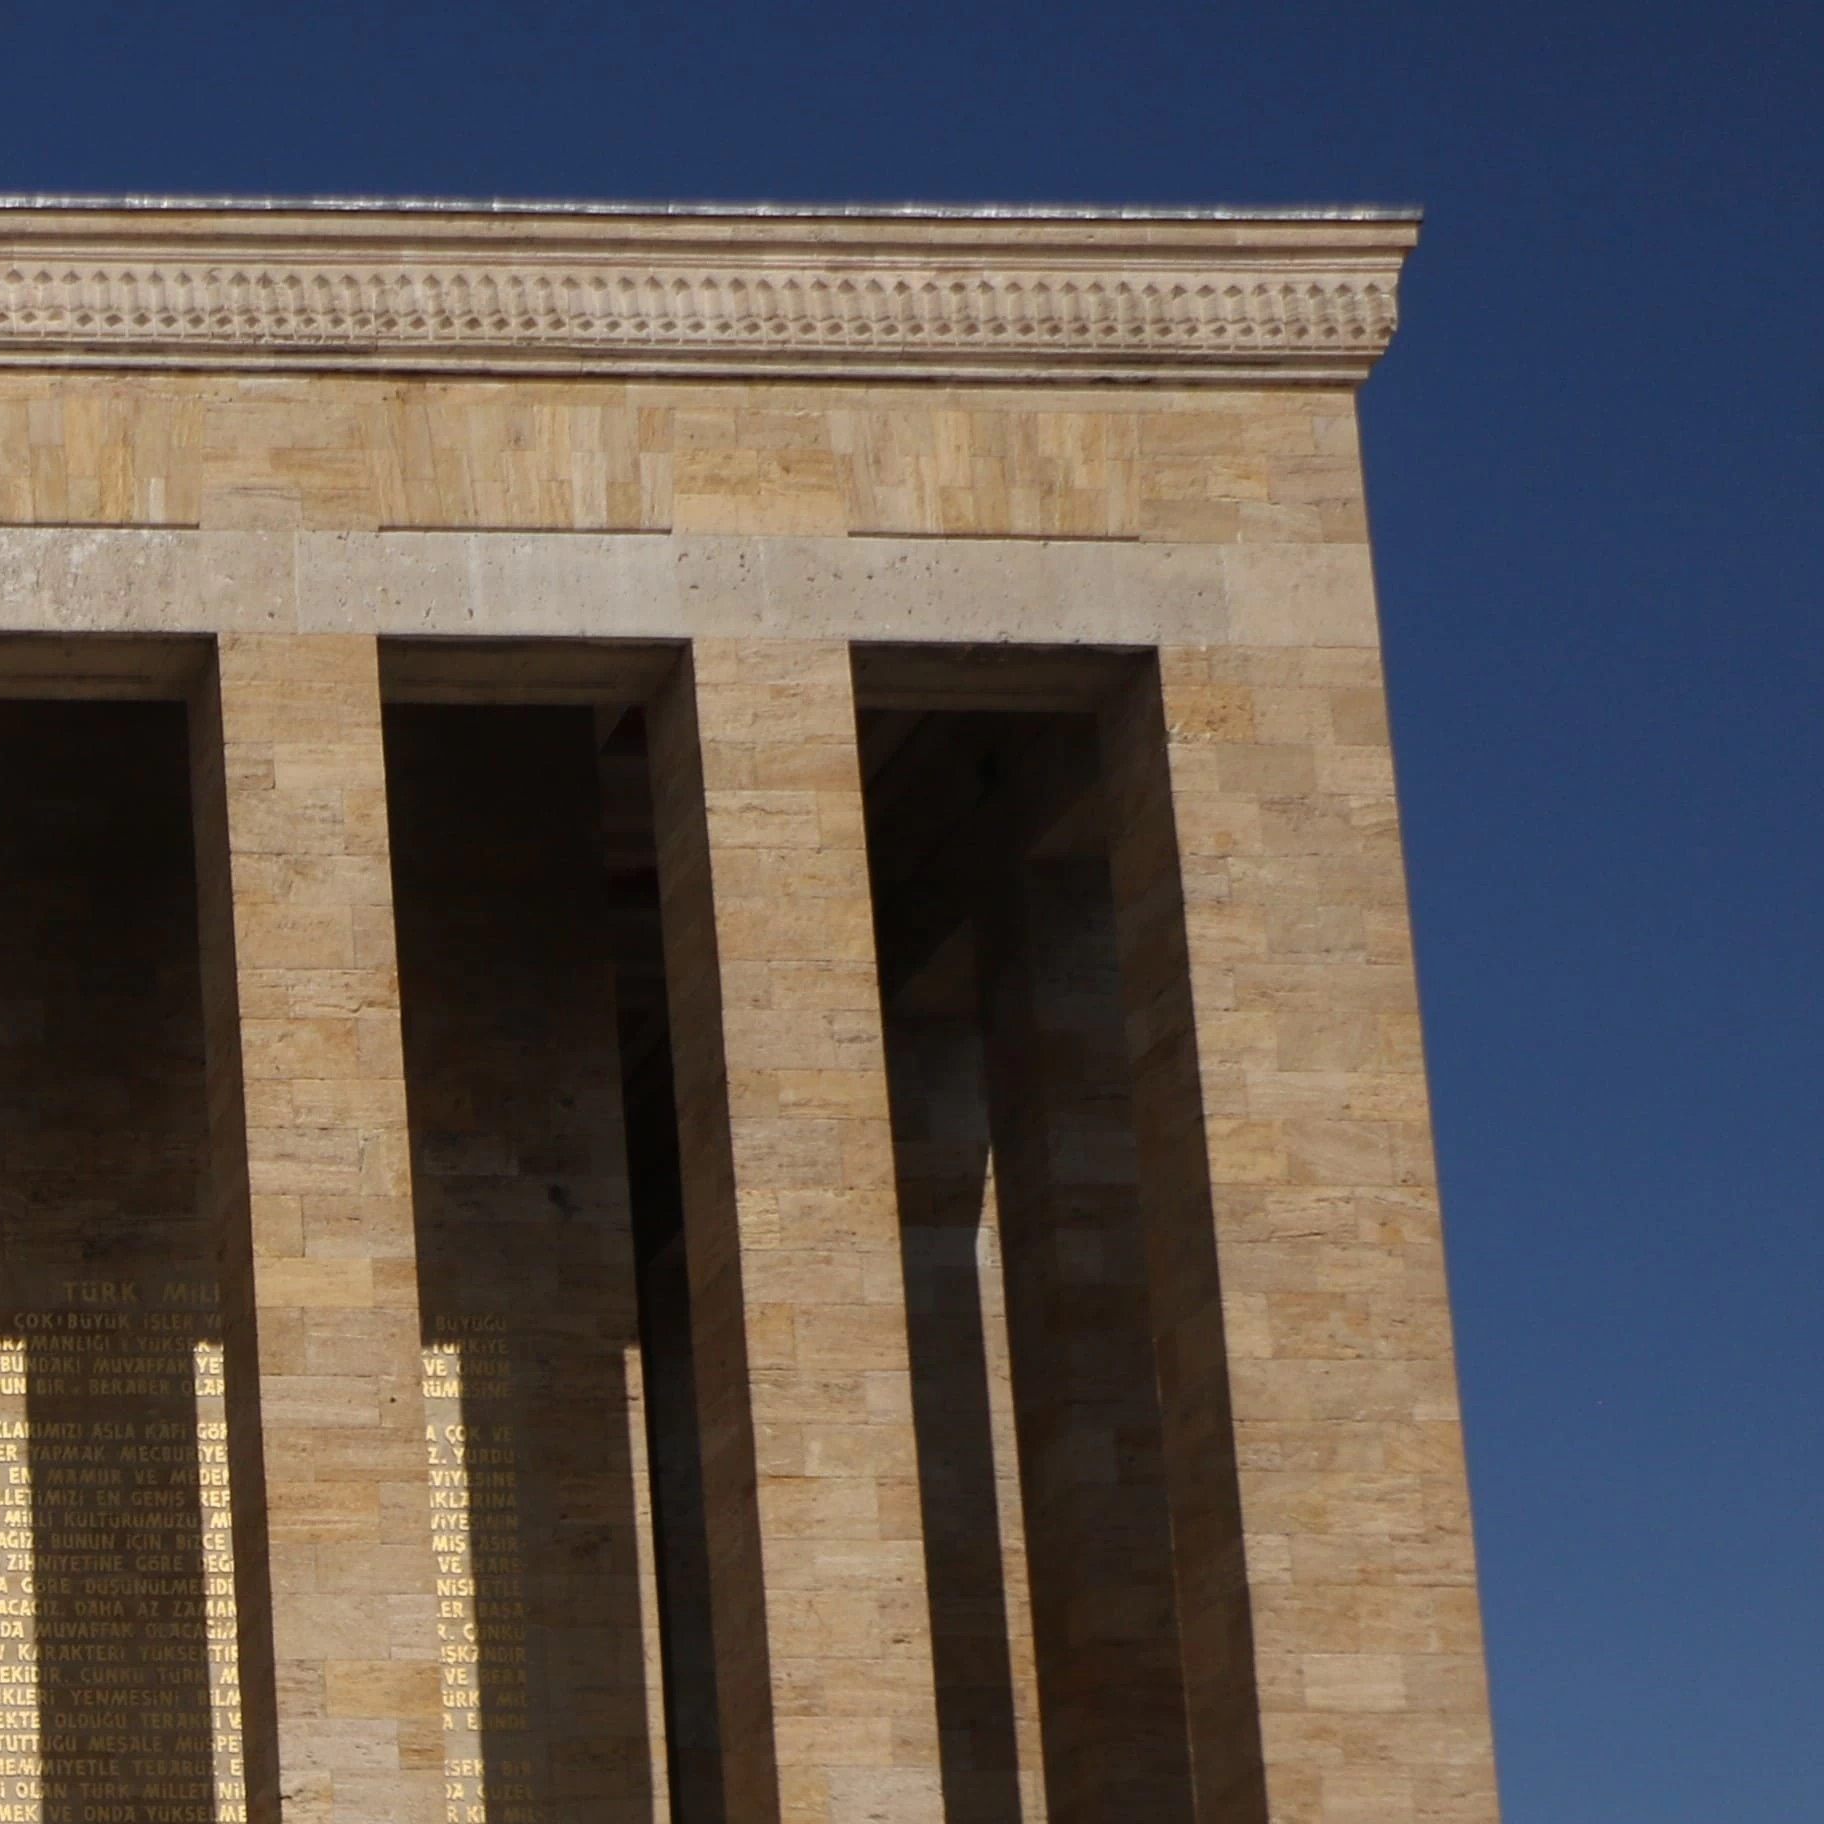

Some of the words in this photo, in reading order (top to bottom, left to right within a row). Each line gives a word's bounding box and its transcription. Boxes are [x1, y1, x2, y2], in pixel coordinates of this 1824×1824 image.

[63, 1282, 138, 1304] TÜRK
[134, 1469, 156, 1485] VE
[96, 1490, 121, 1507] EN
[52, 1532, 115, 1549] BUNUN
[135, 1554, 184, 1572] GÖRE
[437, 1556, 463, 1573] VE
[75, 1600, 124, 1617] DAHA
[137, 1600, 160, 1617] AZ
[0, 1622, 25, 1640] DA
[80, 1783, 132, 1800] TÜRK
[49, 1805, 74, 1822] VE
[83, 1805, 135, 1822] ONDA
